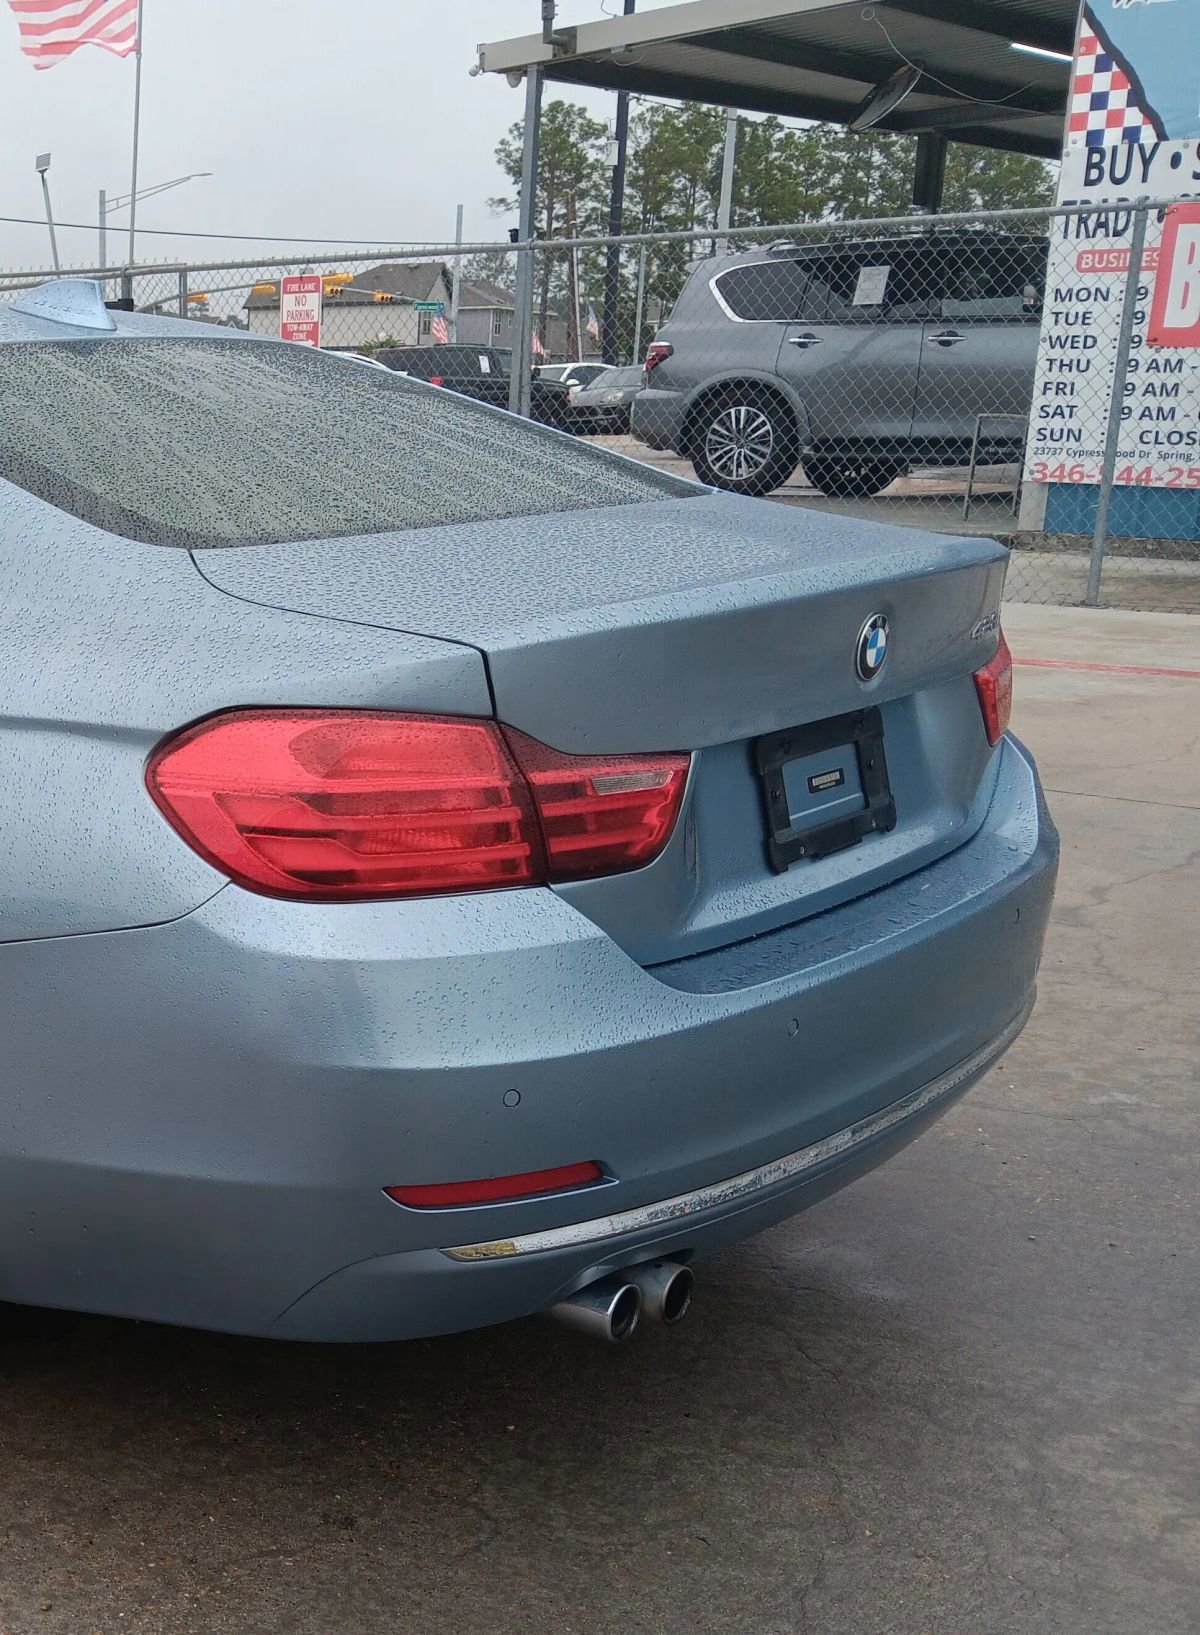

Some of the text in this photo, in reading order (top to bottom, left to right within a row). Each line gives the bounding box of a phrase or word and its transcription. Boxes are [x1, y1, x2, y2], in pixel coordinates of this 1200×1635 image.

[1083, 143, 1161, 187] BUY
[1060, 196, 1148, 240] TRAD
[287, 282, 316, 292] FIRE LANE
[1054, 287, 1111, 303] MON
[1136, 286, 1149, 301] 9
[294, 294, 307, 307] NO
[286, 308, 315, 321] PARKING
[1051, 311, 1093, 326] TUE
[1134, 310, 1146, 325] 9
[292, 332, 308, 341] ZONE
[1048, 334, 1098, 350] WED
[1130, 334, 1143, 349] 9
[1045, 358, 1091, 374] THU
[1127, 358, 1140, 373] 9
[1145, 358, 1185, 374] AM
[1041, 381, 1076, 397] FRI
[1123, 382, 1137, 397] 9
[1141, 381, 1180, 398] AM
[1038, 404, 1078, 420] SAT
[1120, 405, 1133, 421] 9
[1138, 405, 1177, 422] AM
[1035, 427, 1083, 443] SUN
[1139, 429, 1200, 446] CLOS
[1033, 446, 1064, 456] 23737
[1065, 447, 1136, 459] Cypressood
[1138, 449, 1151, 459] Dr
